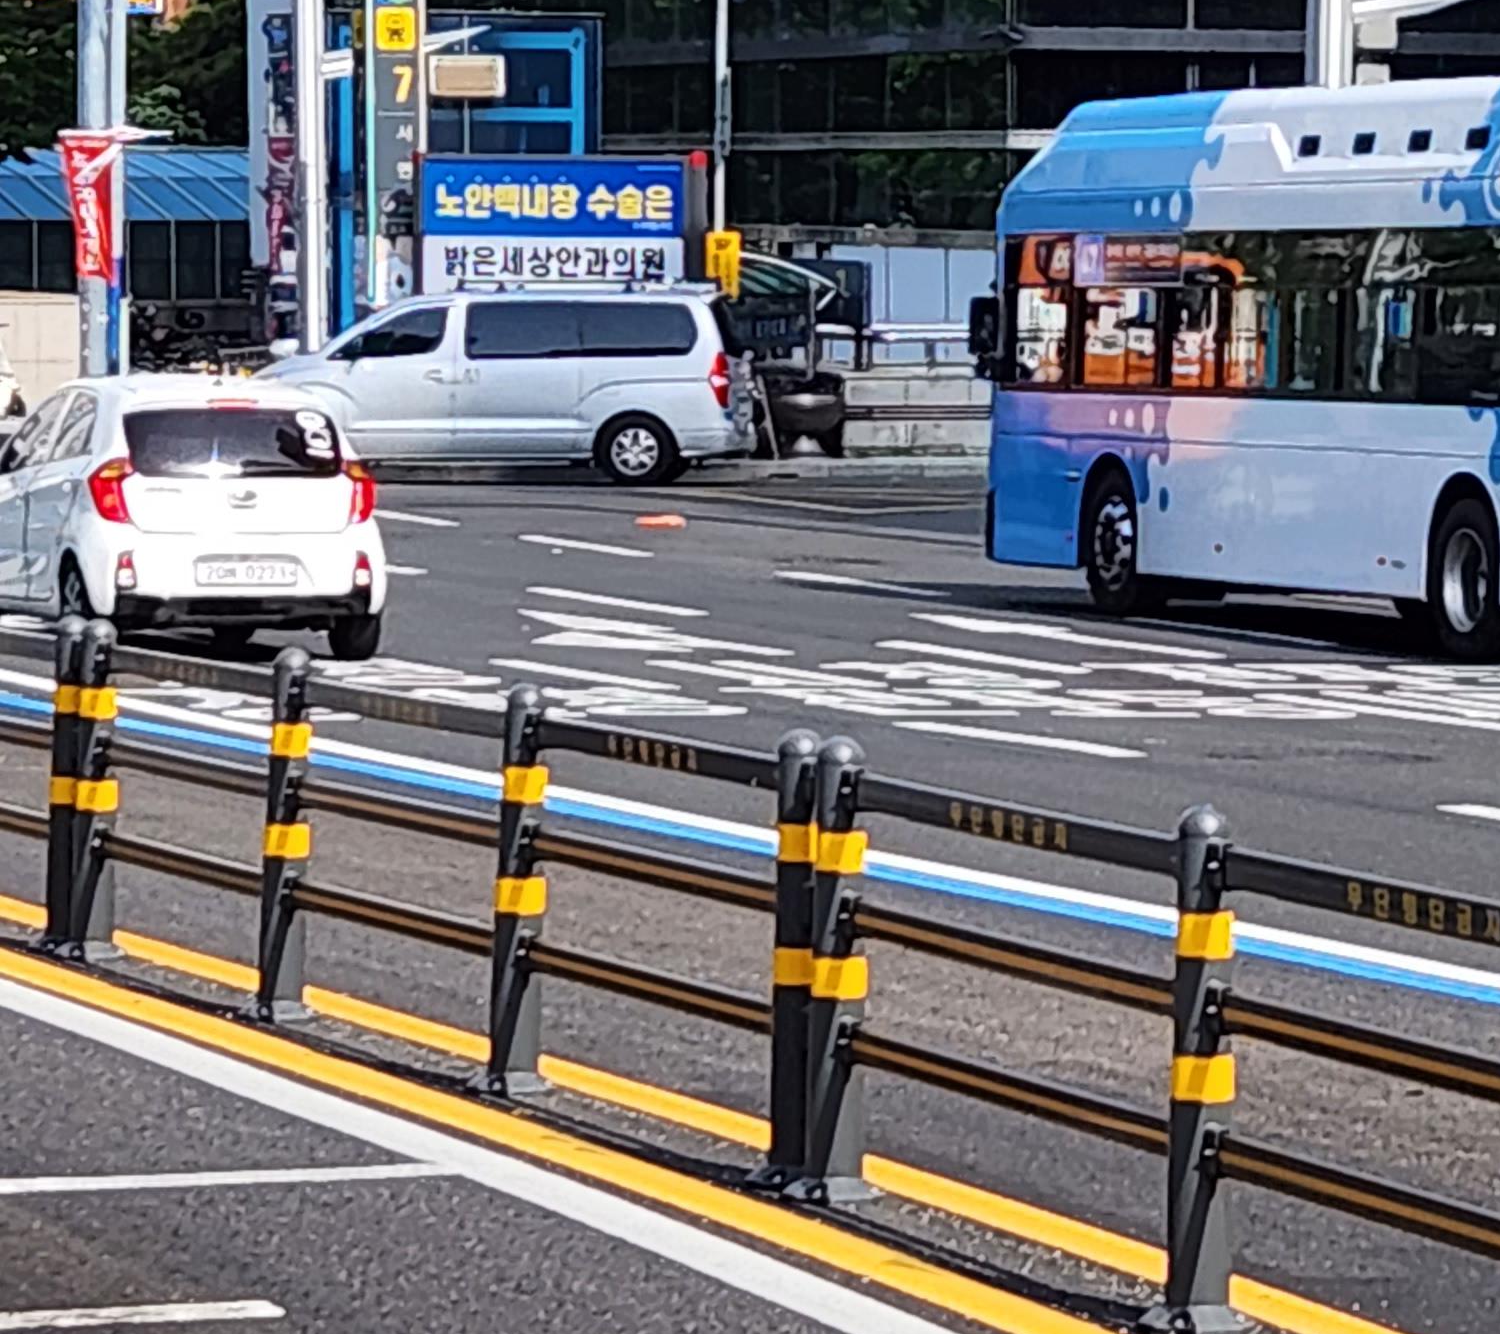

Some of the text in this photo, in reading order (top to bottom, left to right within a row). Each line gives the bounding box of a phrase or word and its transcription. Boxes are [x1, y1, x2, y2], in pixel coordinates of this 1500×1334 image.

[434, 183, 674, 220] 노안백내장 수술은
[444, 245, 666, 280] 밝은세상안과의원
